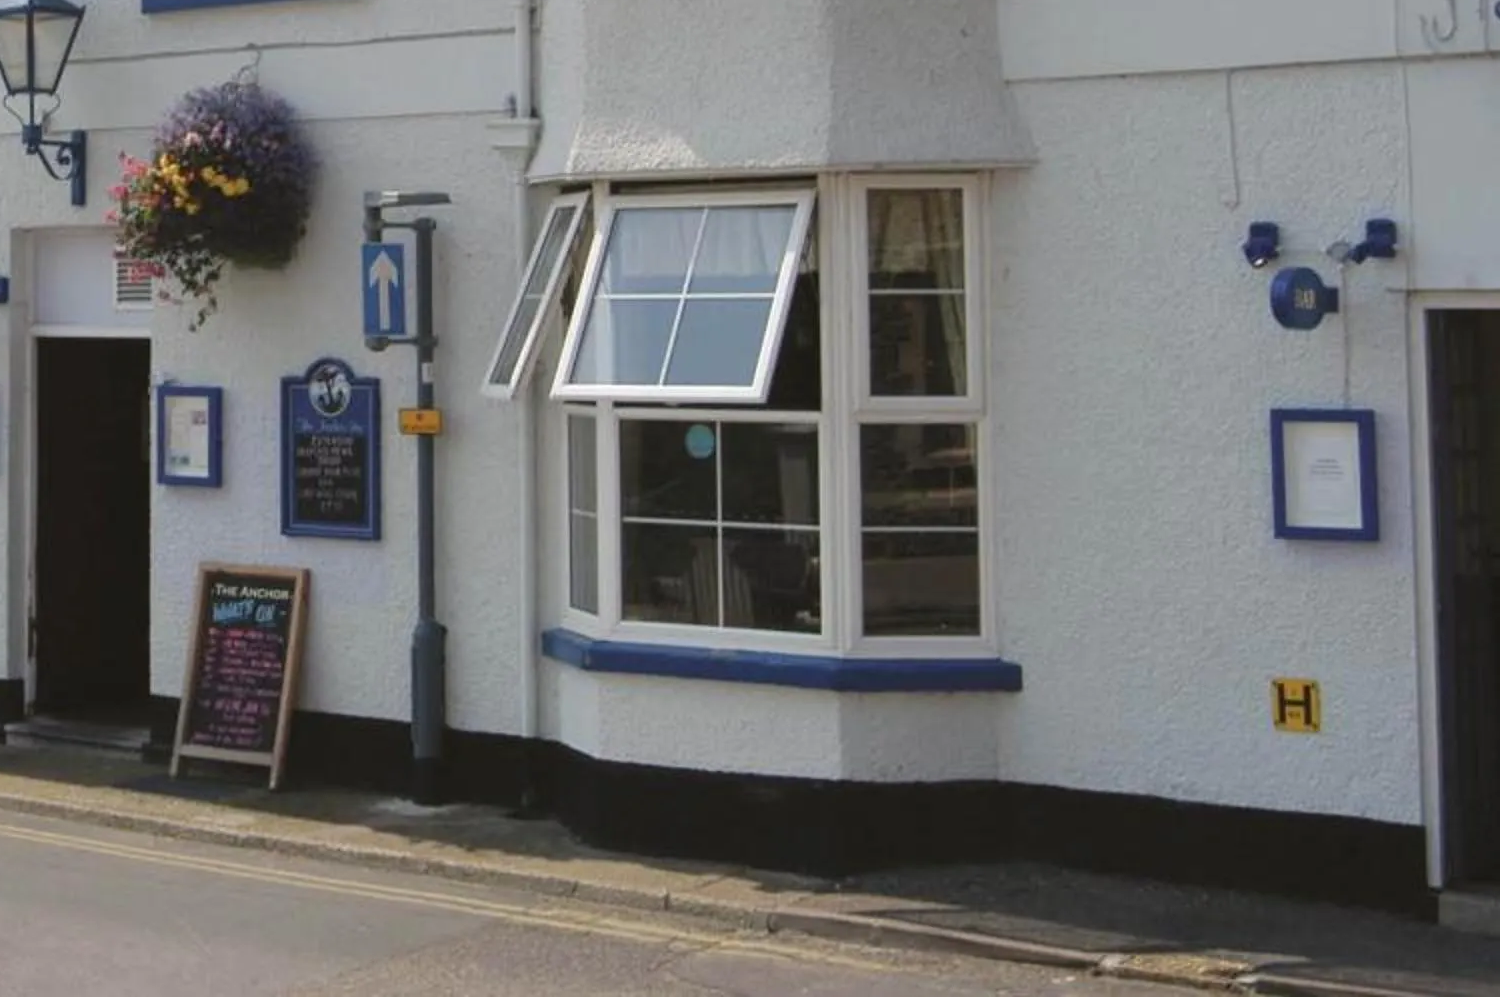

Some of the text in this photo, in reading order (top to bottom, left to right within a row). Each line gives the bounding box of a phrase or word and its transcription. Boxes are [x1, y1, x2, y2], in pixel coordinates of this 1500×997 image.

[215, 583, 289, 600] THE ANCHOR
[1277, 682, 1312, 726] H
